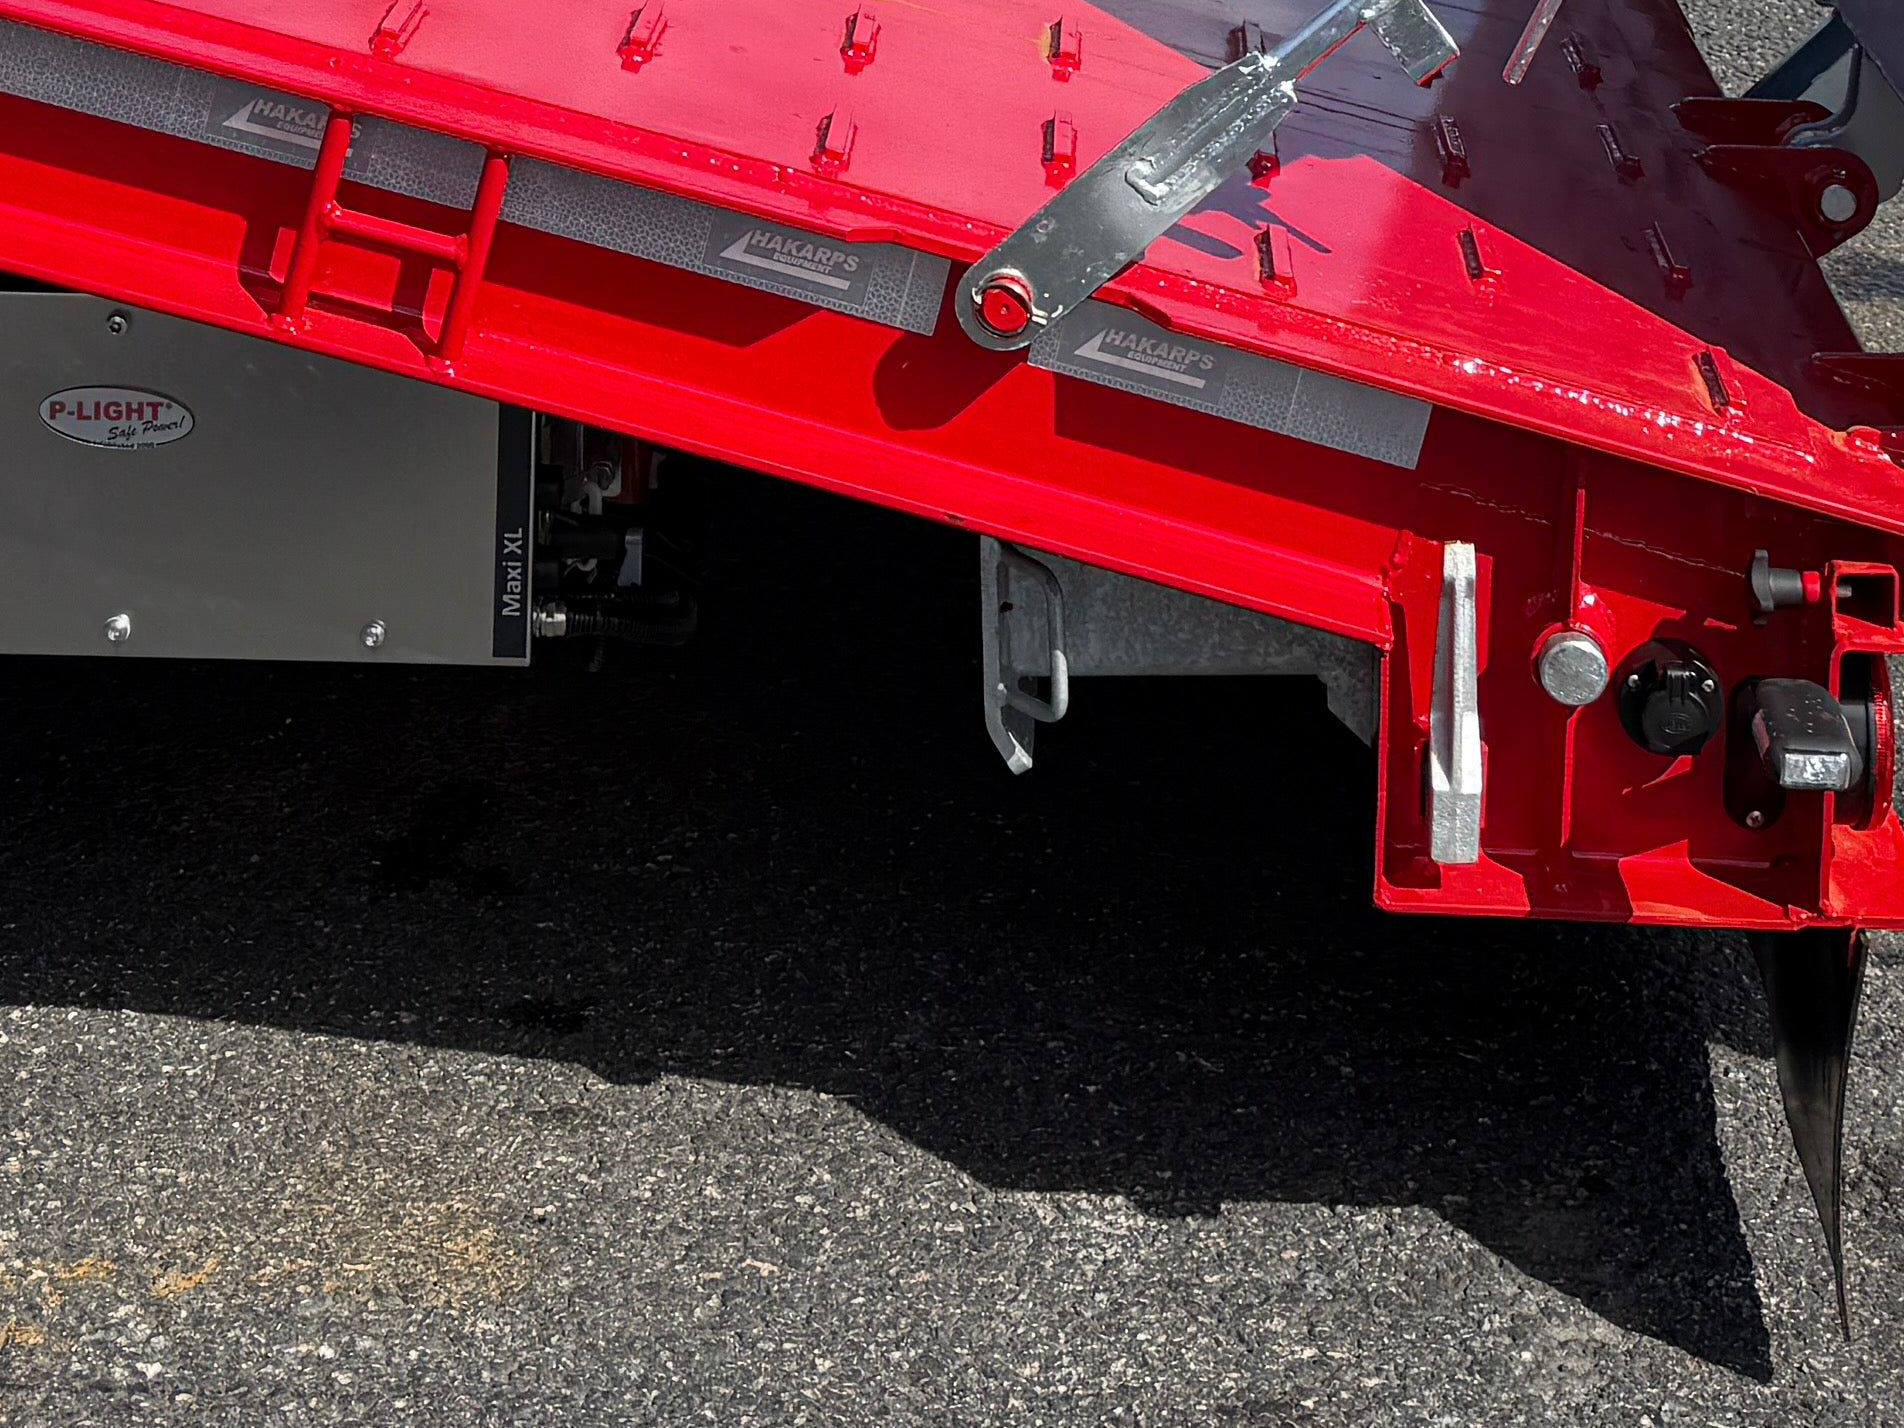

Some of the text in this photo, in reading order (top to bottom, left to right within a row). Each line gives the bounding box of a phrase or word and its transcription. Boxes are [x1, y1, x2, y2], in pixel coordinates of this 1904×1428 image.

[749, 229, 860, 272] HAKARPS
[772, 251, 833, 274] EQUIPMENT
[1104, 328, 1215, 370] HAKARPS
[1127, 350, 1188, 373] EQUIPMENT
[49, 400, 165, 422] P-LIGHT
[107, 415, 186, 441] Safe Power!
[502, 527, 523, 617] Maxi XL
